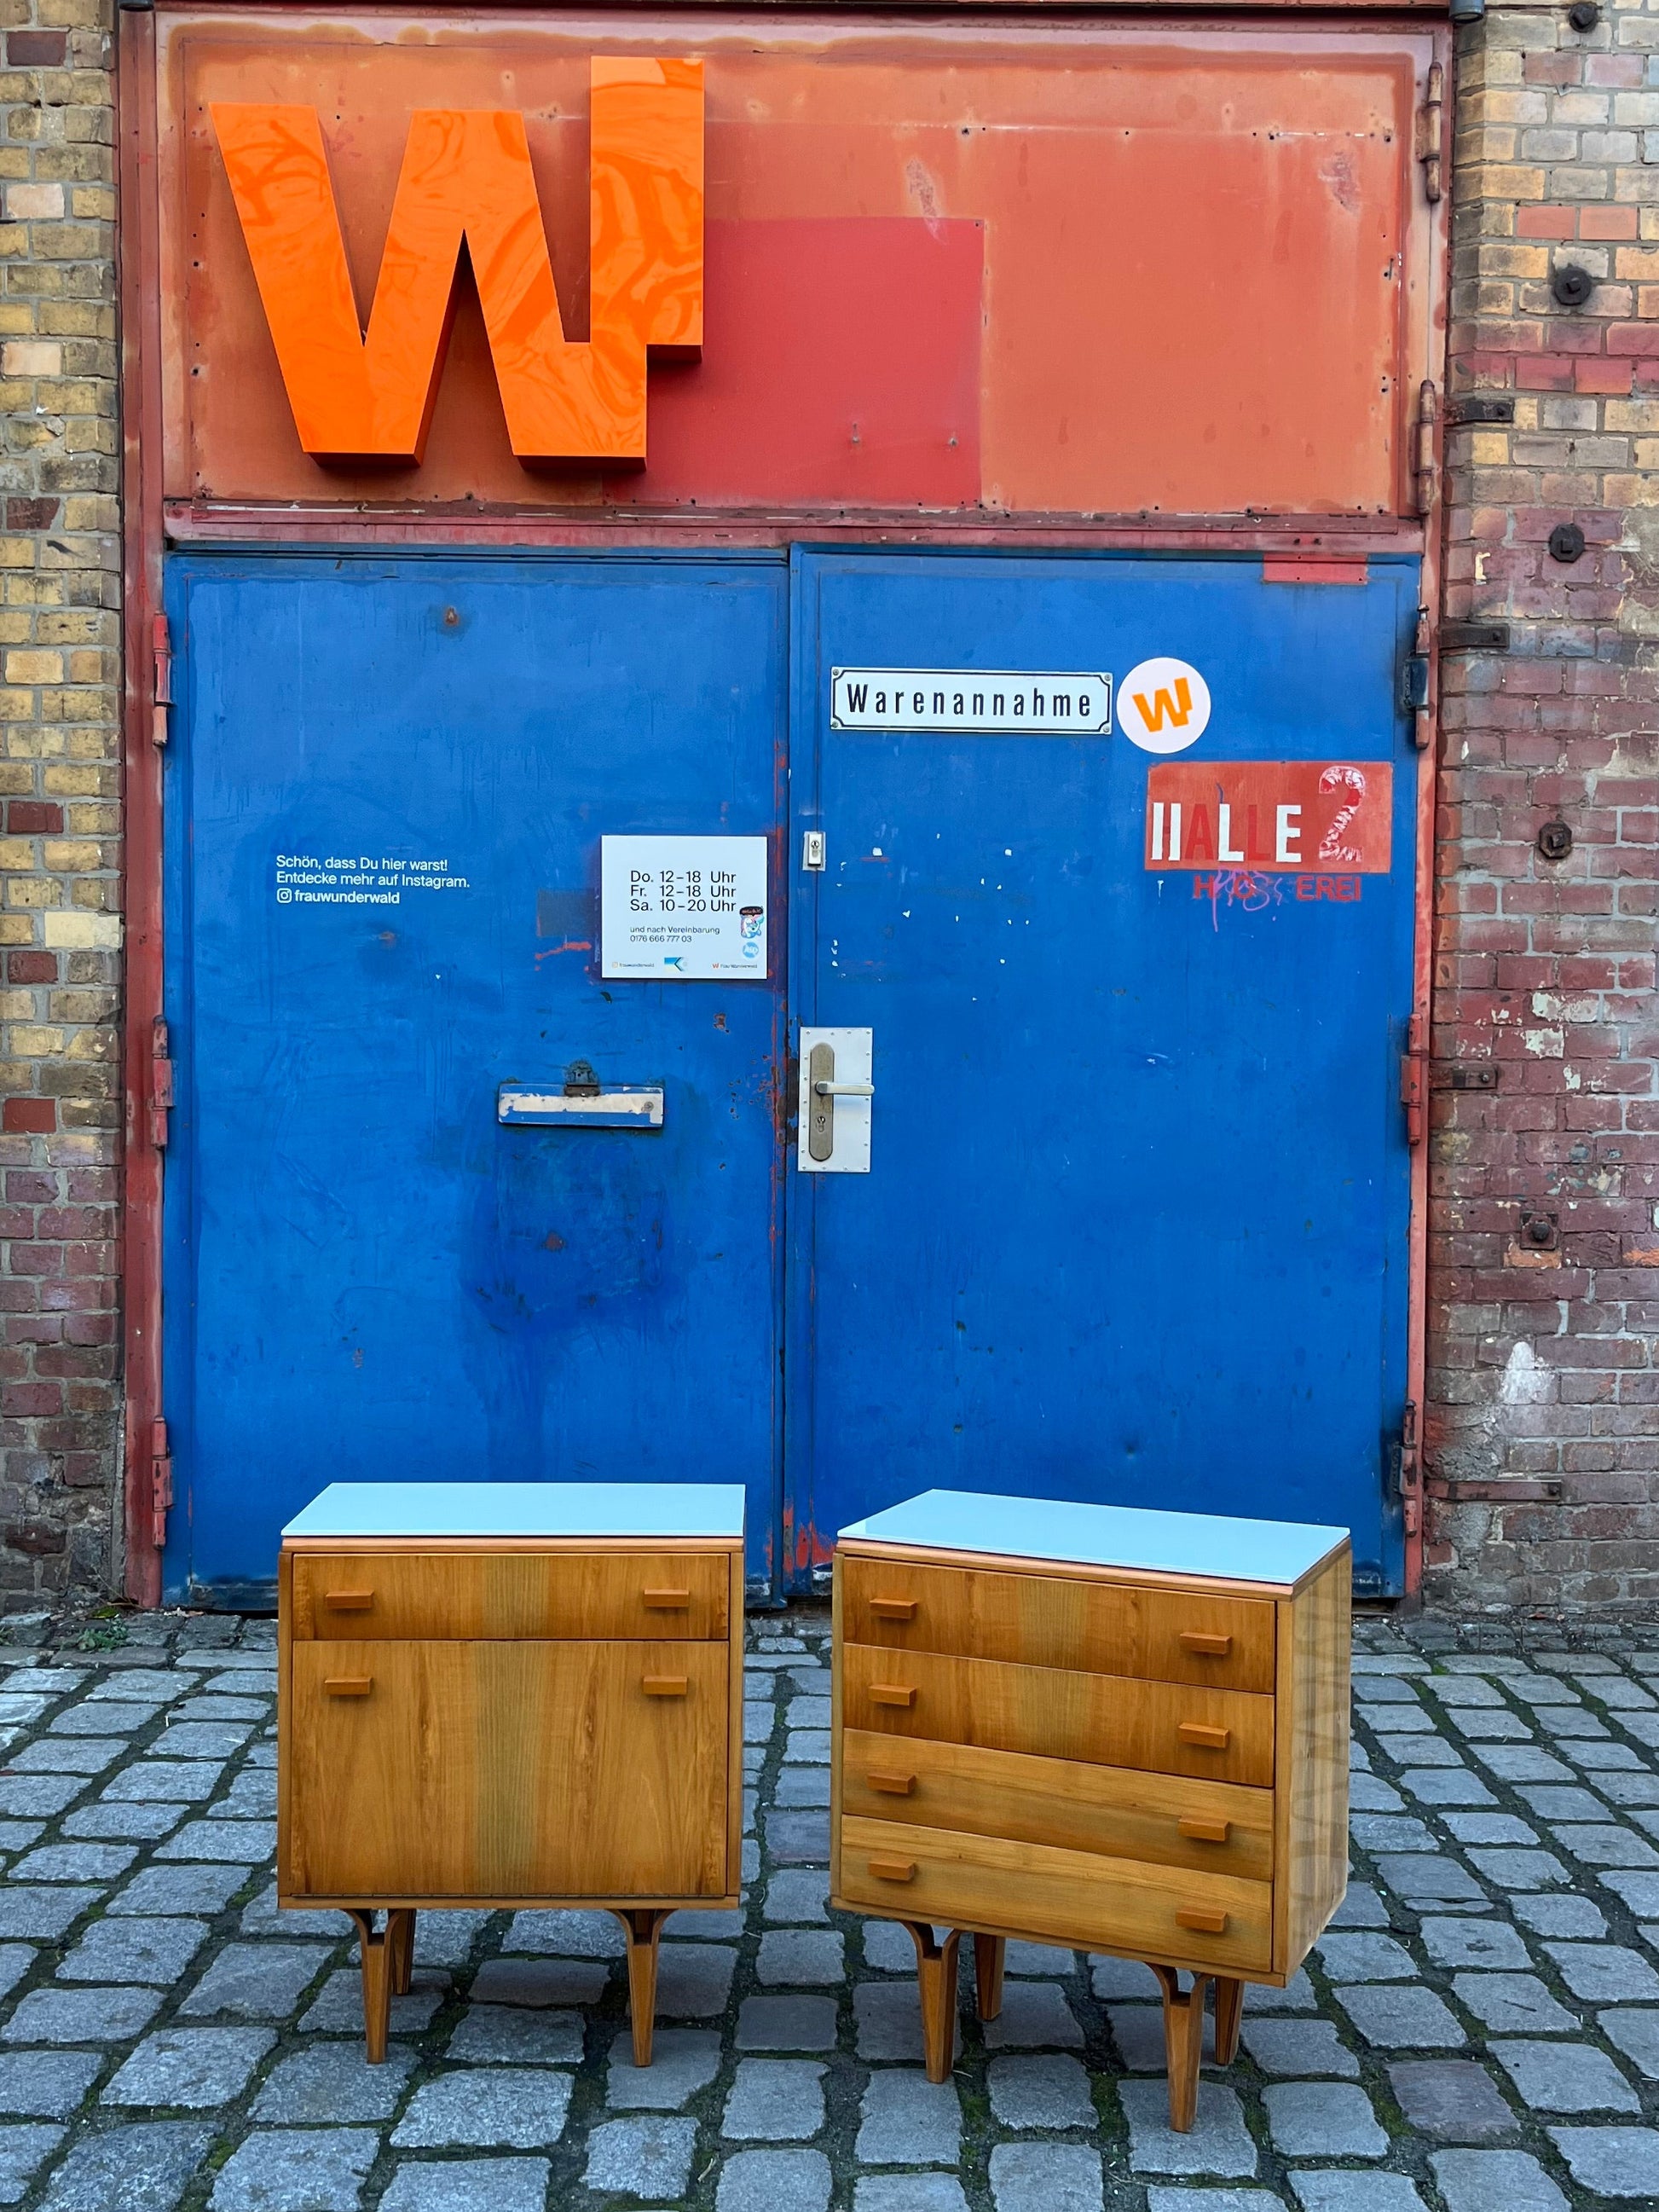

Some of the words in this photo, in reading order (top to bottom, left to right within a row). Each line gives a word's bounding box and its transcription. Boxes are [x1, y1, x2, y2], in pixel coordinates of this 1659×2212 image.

[209, 55, 704, 472] W
[847, 684, 1090, 716] Warenannahme
[1132, 676, 1193, 733] W
[1319, 766, 1365, 863] 2
[275, 854, 322, 871] Schön,
[324, 856, 356, 870] dass
[360, 856, 379, 870] Du
[382, 857, 408, 871] hier
[409, 859, 448, 871] warst!
[276, 871, 338, 885] Entdecke
[340, 872, 376, 886] mehr
[378, 873, 399, 886] auf
[402, 873, 471, 890] Instagram.
[630, 870, 654, 883] Do.
[710, 871, 737, 883] Uhr
[294, 889, 399, 903] frauwunderwald
[630, 884, 647, 897] Fr.
[710, 885, 737, 898] Uhr
[630, 898, 653, 912] Sa.
[710, 899, 737, 912] Uhr
[668, 926, 720, 935] Vereinbarung
